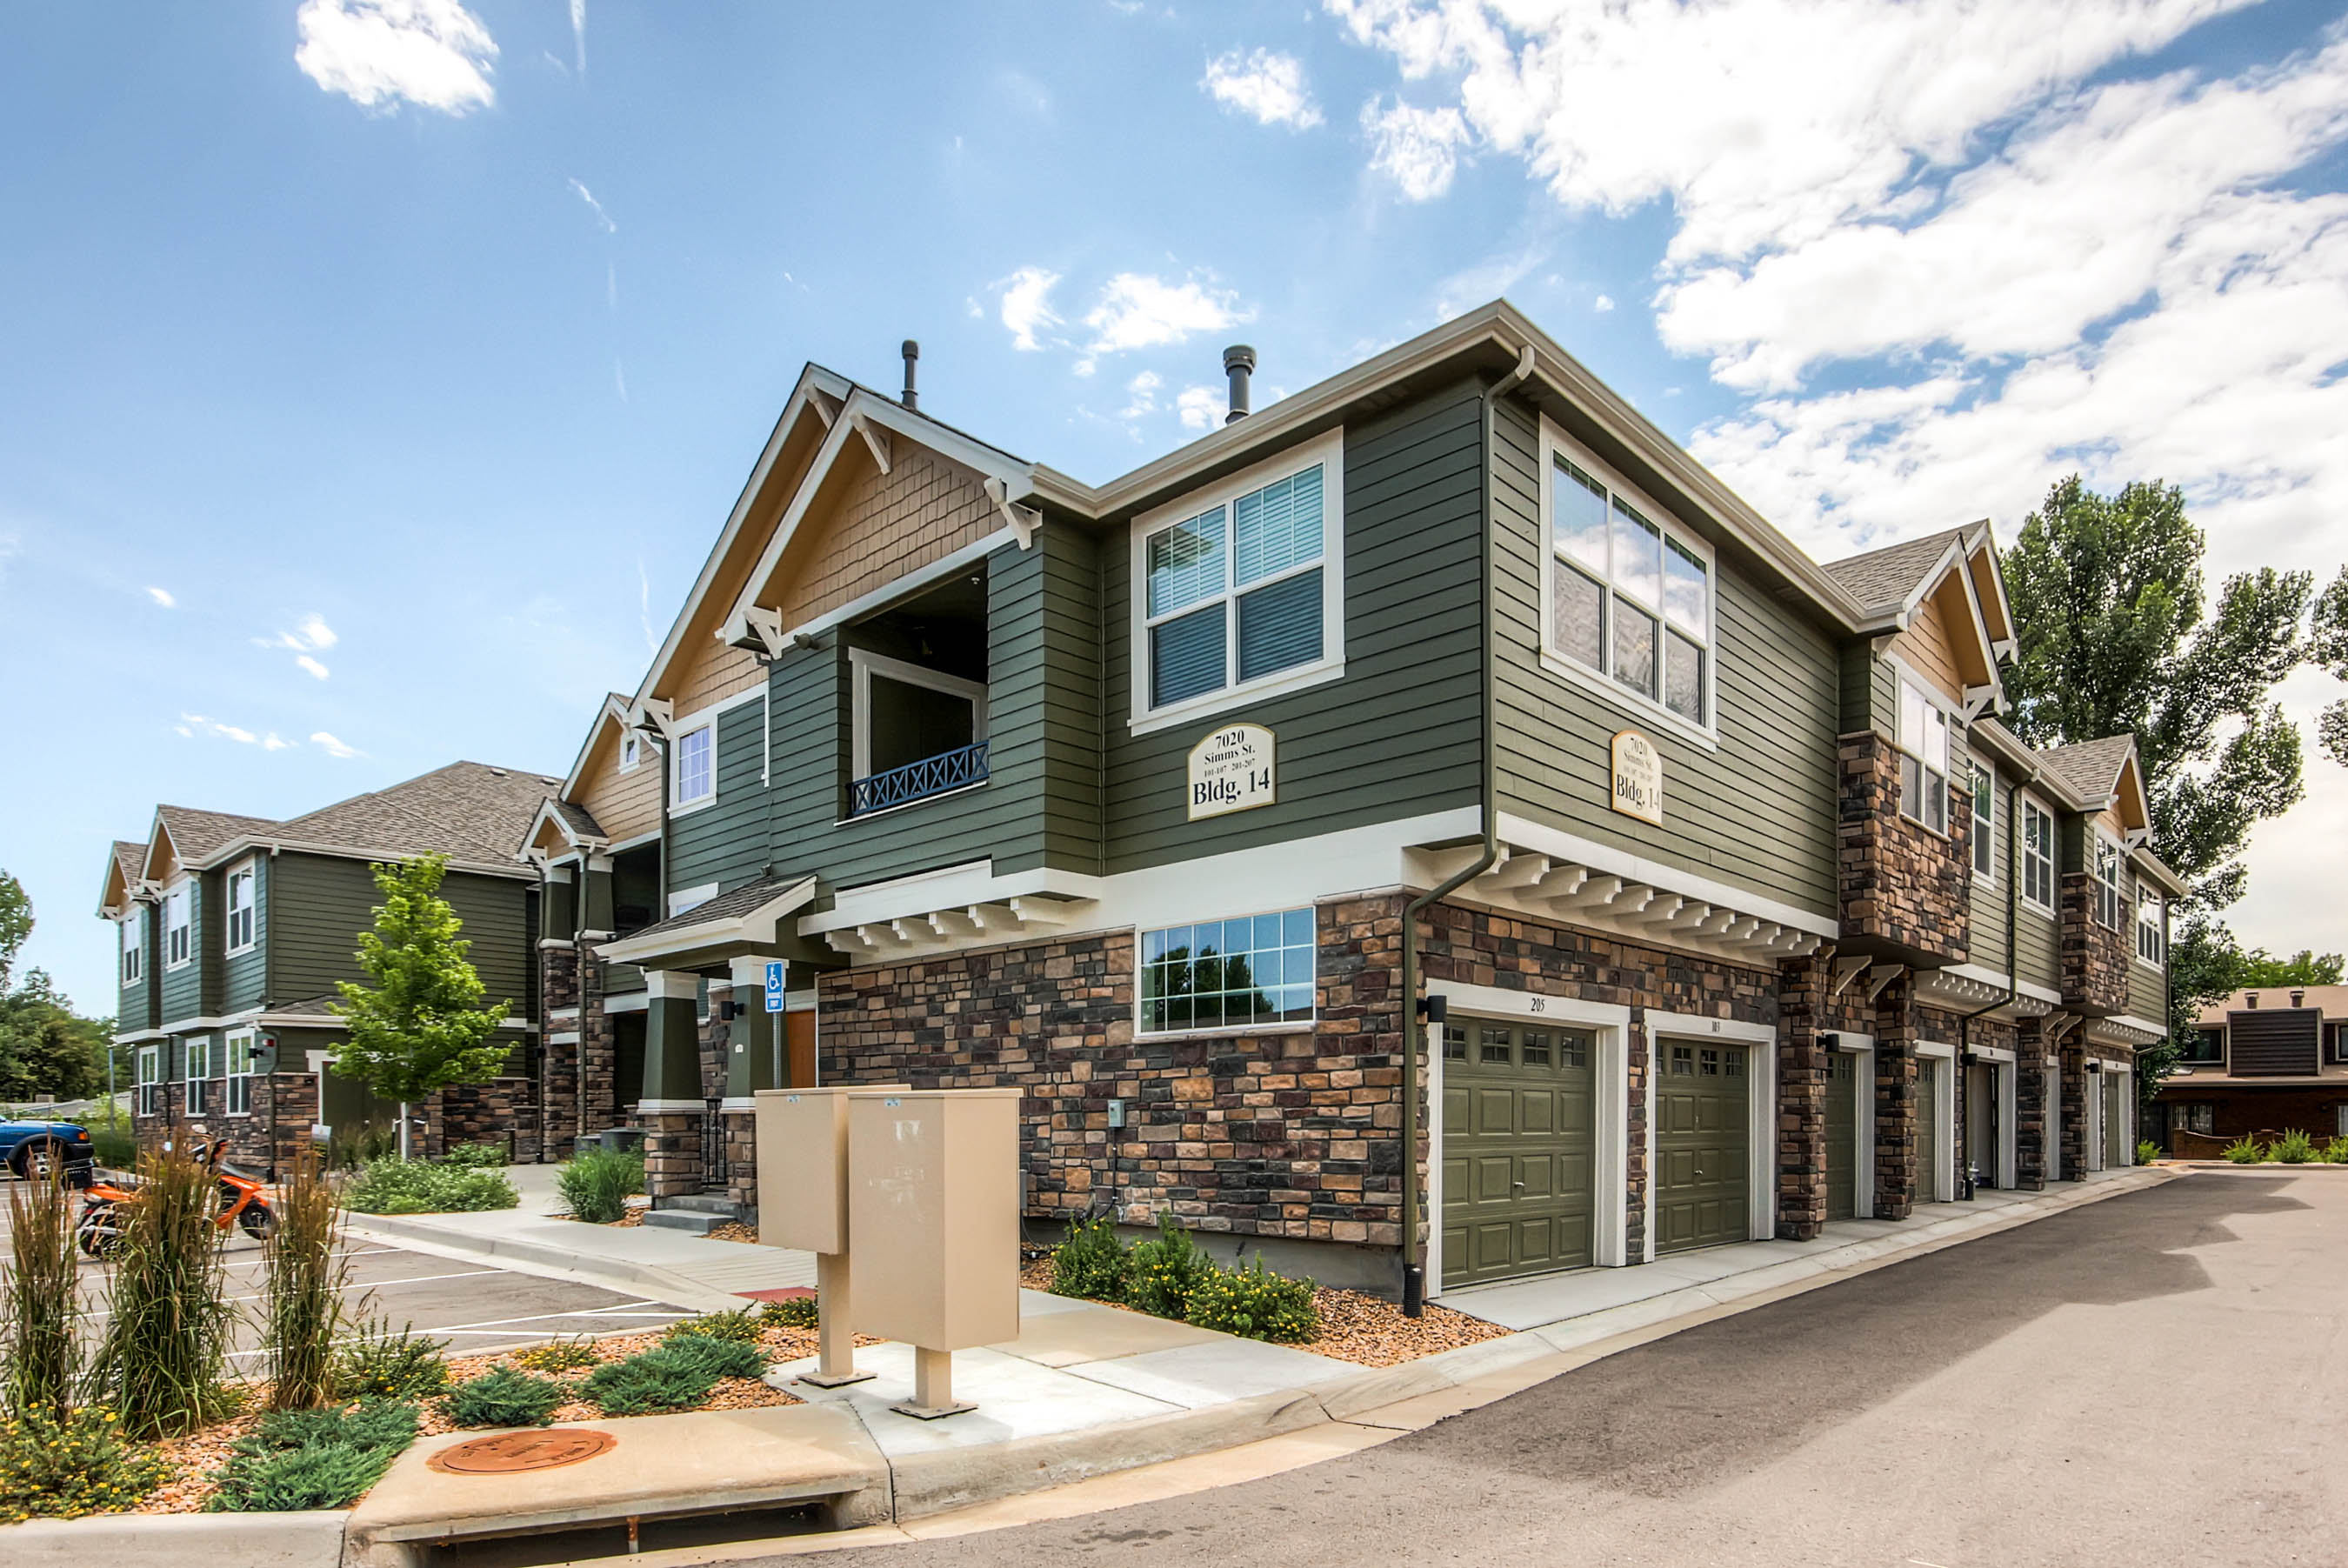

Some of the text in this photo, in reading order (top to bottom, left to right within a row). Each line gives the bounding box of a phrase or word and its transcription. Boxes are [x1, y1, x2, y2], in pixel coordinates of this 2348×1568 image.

[1216, 730, 1244, 749] 7020
[1204, 744, 1256, 765] Simms St.
[1193, 766, 1270, 804] Bldg. 14
[1617, 774, 1659, 811] Bldg. 14
[1531, 998, 1544, 1012] 205
